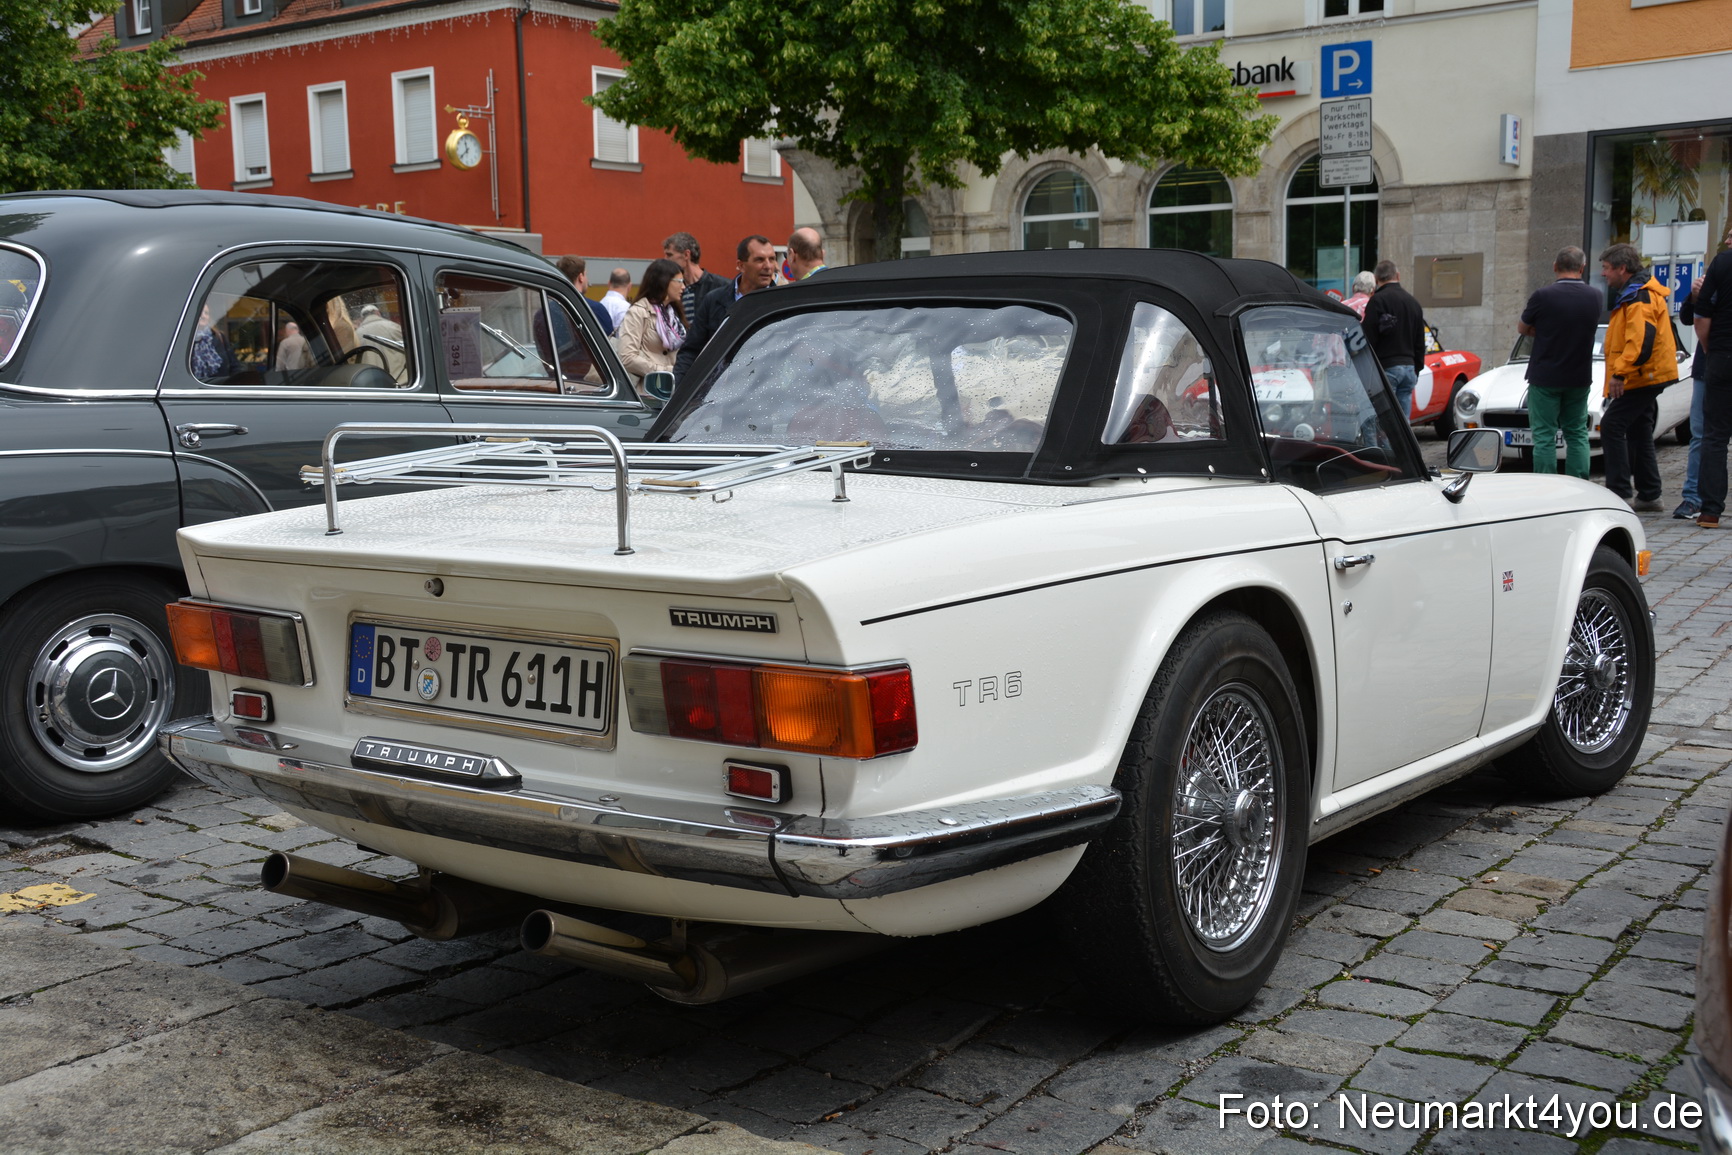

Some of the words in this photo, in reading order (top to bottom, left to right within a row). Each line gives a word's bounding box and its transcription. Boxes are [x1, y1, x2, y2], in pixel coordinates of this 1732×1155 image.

[1229, 56, 1295, 87] sbank
[1332, 49, 1361, 91] P
[1323, 111, 1368, 122] Parkschein
[1330, 105, 1344, 113] nur
[1327, 121, 1365, 130] werktags
[1323, 143, 1333, 151] Sa
[1658, 265, 1688, 276] HER
[451, 344, 461, 368] 394
[1256, 390, 1283, 399] CIA
[1511, 433, 1525, 443] NM
[672, 610, 772, 631] TRIUMPH
[357, 667, 366, 683] D
[375, 634, 420, 692] BT
[446, 642, 491, 703] TR
[501, 651, 604, 719] 611H
[952, 670, 1023, 707] TR6
[365, 743, 476, 771] TRIUMPH
